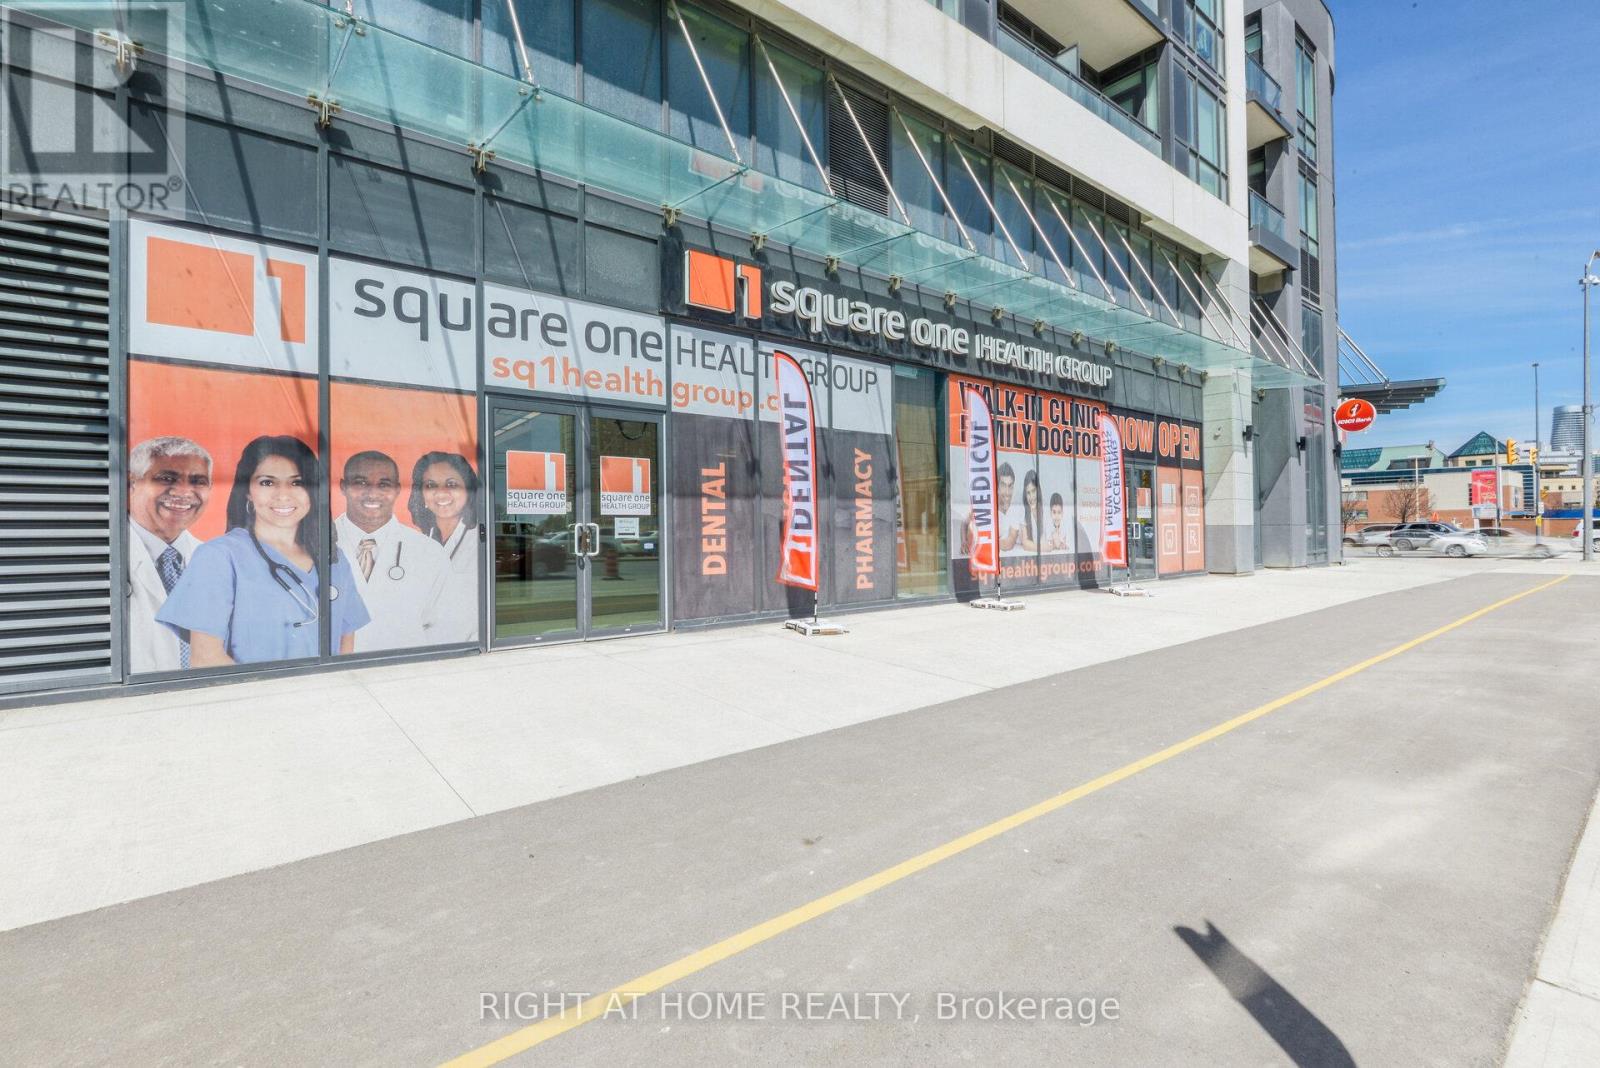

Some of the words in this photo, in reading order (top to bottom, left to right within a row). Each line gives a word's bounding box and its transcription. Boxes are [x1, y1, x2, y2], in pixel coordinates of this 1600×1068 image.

[354, 278, 568, 347] square
[584, 320, 664, 362] one
[677, 335, 775, 379] HEALT
[800, 358, 878, 394] GROUP
[770, 280, 905, 340] square
[911, 317, 969, 355] one
[975, 333, 1054, 375] HEALTH
[1055, 355, 1113, 387] GROUP
[961, 413, 1033, 450] FMILY
[1050, 398, 1101, 430] CLINIC
[1111, 415, 1154, 453] NOW
[1158, 422, 1200, 460] OPEN
[507, 491, 544, 502] square
[507, 501, 538, 509] HEALTH
[601, 494, 633, 503] square
[601, 502, 627, 510] HEALTH
[702, 462, 727, 575] DENTAL
[854, 447, 874, 590] PHARMACY
